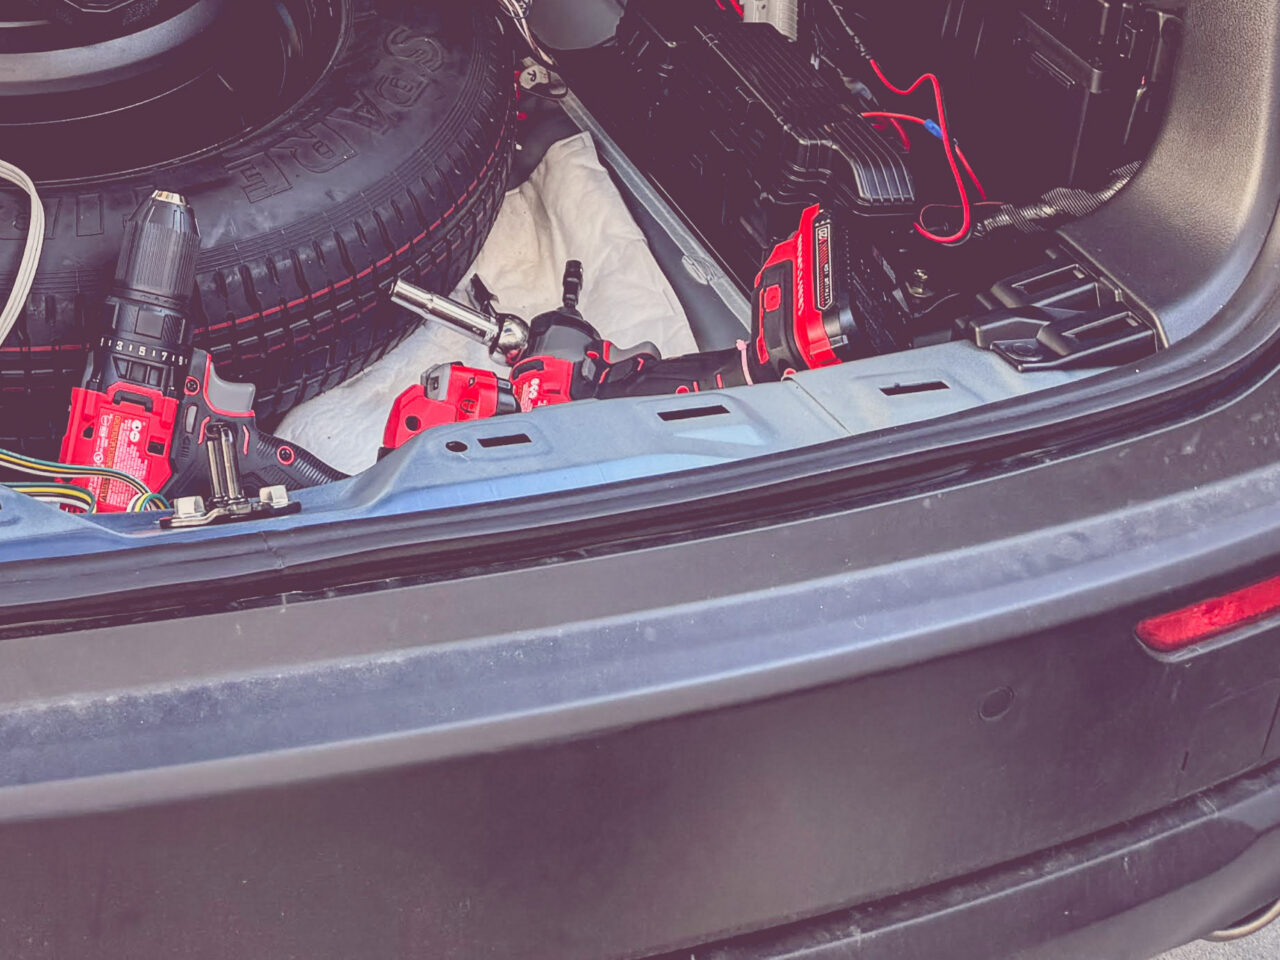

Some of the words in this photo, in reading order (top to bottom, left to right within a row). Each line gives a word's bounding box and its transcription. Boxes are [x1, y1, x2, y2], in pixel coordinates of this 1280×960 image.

[223, 24, 446, 204] SPARE
[116, 341, 123, 351] 3
[138, 346, 146, 356] 5
[161, 351, 168, 361] 7
